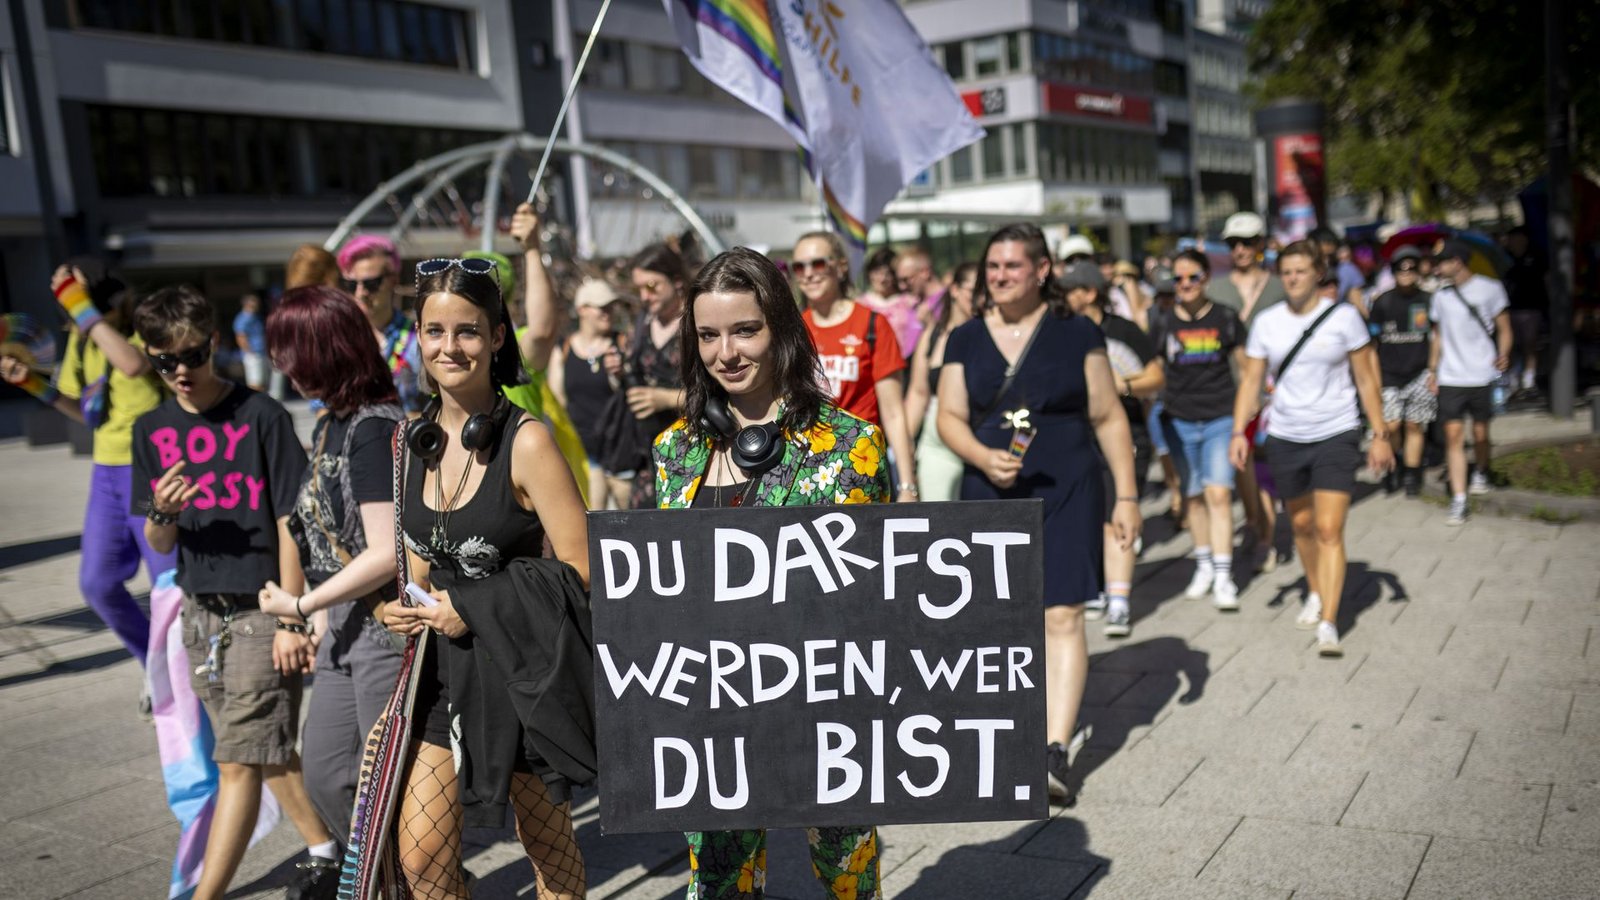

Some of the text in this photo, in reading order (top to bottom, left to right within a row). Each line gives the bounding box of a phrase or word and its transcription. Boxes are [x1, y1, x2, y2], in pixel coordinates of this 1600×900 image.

[150, 422, 250, 470] BOY
[150, 471, 266, 511] SSY
[599, 512, 1031, 620] DU DARFST
[596, 639, 1035, 709] WERDEN, WER
[653, 714, 1031, 810] DU BIST.
